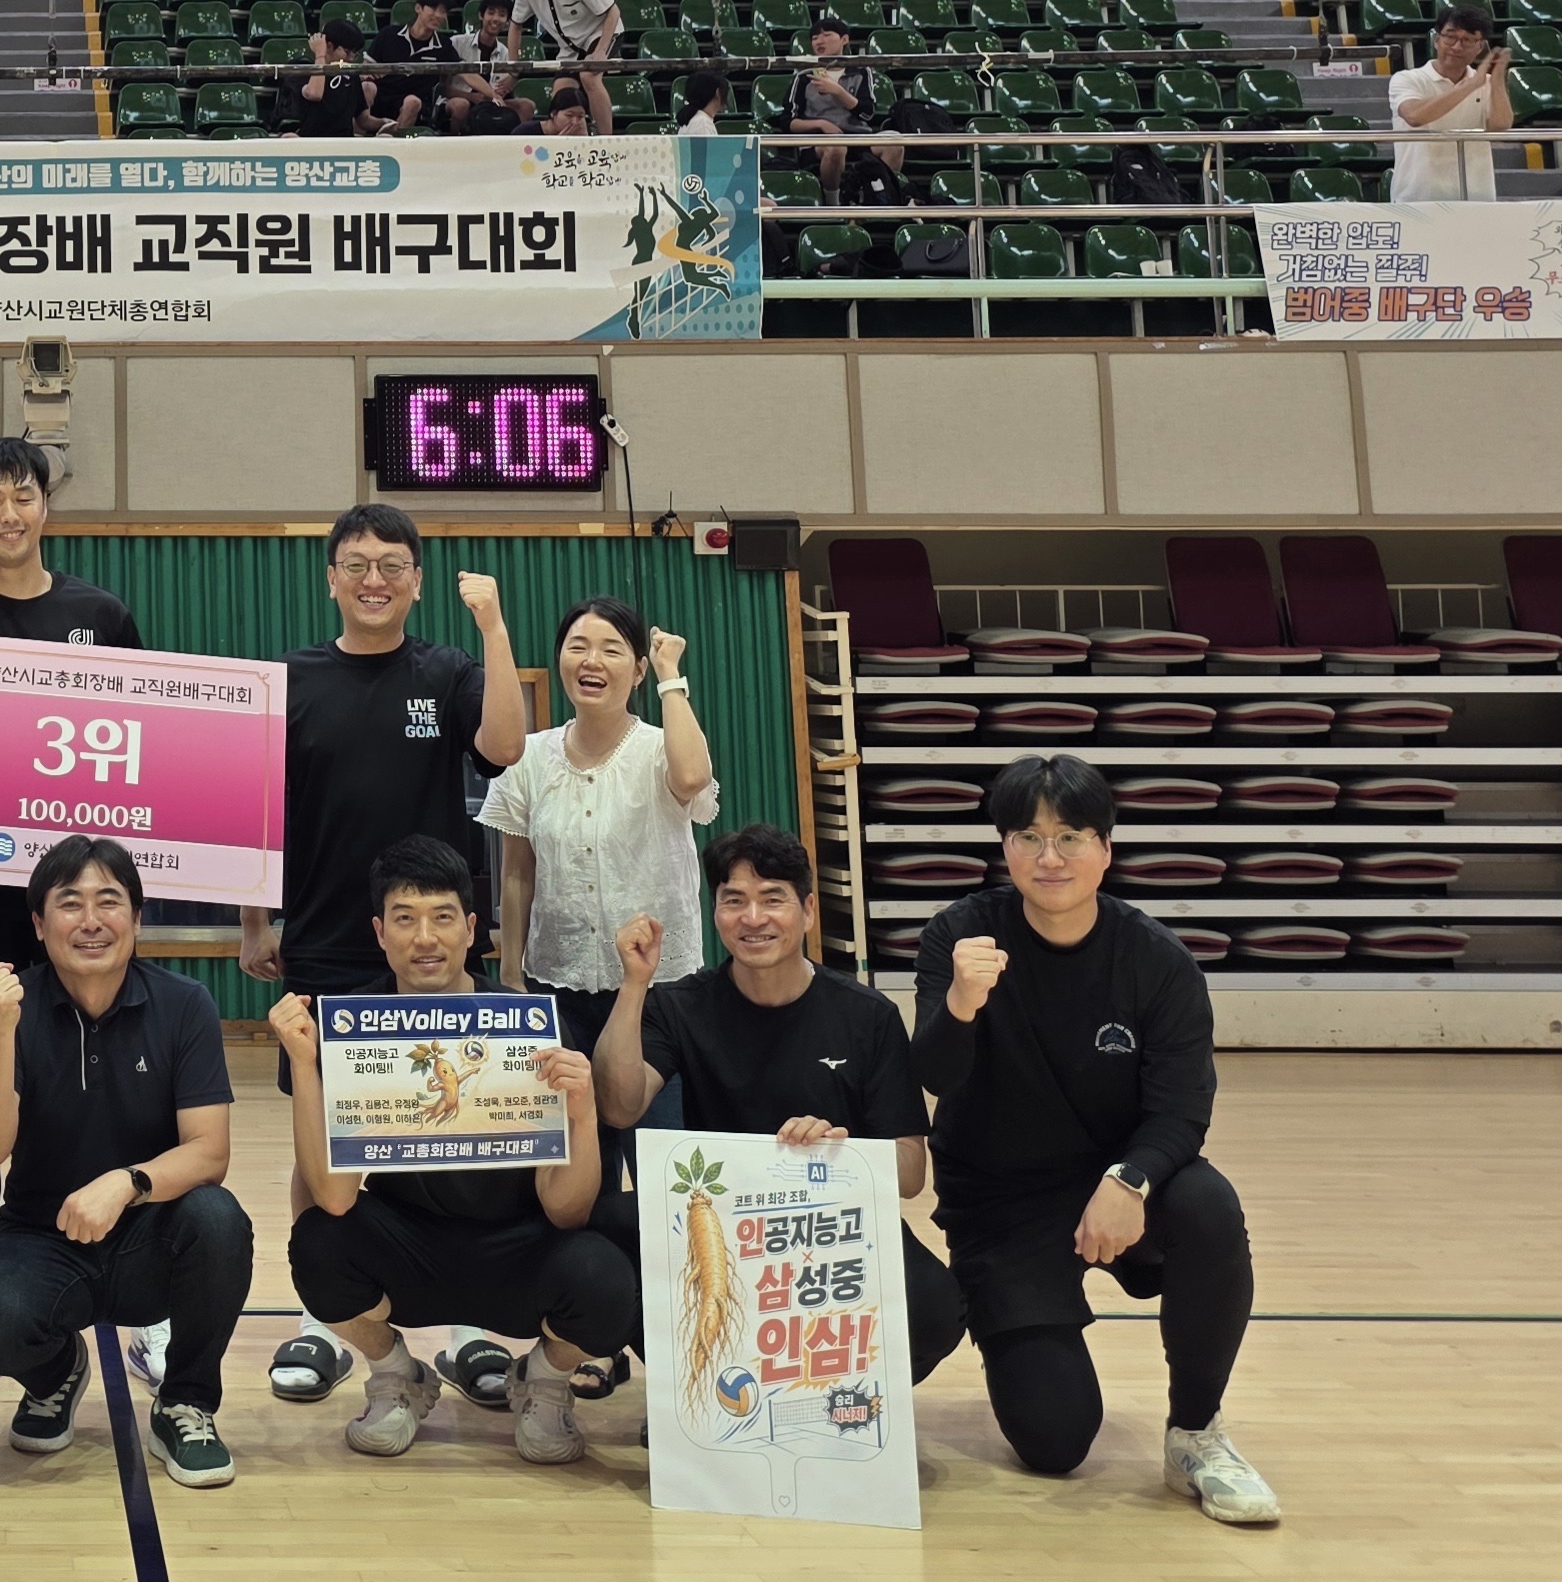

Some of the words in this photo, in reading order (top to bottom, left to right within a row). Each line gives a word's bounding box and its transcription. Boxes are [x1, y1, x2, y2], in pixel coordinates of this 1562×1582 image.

[42, 162, 112, 188] 미래를
[119, 161, 176, 190] 열다,
[182, 160, 278, 188] 함께하는
[284, 160, 381, 188] 양산교총
[133, 212, 312, 275] 교직원
[333, 211, 577, 274] 배구대회
[1271, 221, 1342, 250] 완벽한
[1346, 221, 1401, 250] 압도!
[1276, 254, 1369, 282] 거침없는
[1375, 254, 1429, 282] 질주!
[1285, 286, 1371, 322] 범어중
[1377, 286, 1466, 322] 배구단
[1473, 286, 1532, 322] 우승
[409, 387, 594, 479] 6:06
[129, 676, 253, 705] 교직원배구대회
[406, 699, 437, 712] LIVE
[407, 711, 437, 725] THE
[404, 725, 441, 738] GOAL
[32, 715, 142, 785] 3위
[17, 797, 153, 832] 100,000원
[359, 1008, 472, 1032] 인삼Volley
[477, 1008, 521, 1029] Ball
[345, 1048, 399, 1060] 인공지능고
[364, 1144, 393, 1159] 양산
[810, 1165, 825, 1180] AI
[734, 1194, 753, 1207] 코트
[755, 1193, 765, 1206] 위
[767, 1191, 786, 1204] 최강
[735, 1207, 864, 1261] 인공지능고
[754, 1257, 866, 1314] 삼성중
[756, 1314, 873, 1387] 인삼!
[834, 1394, 854, 1406] 승리
